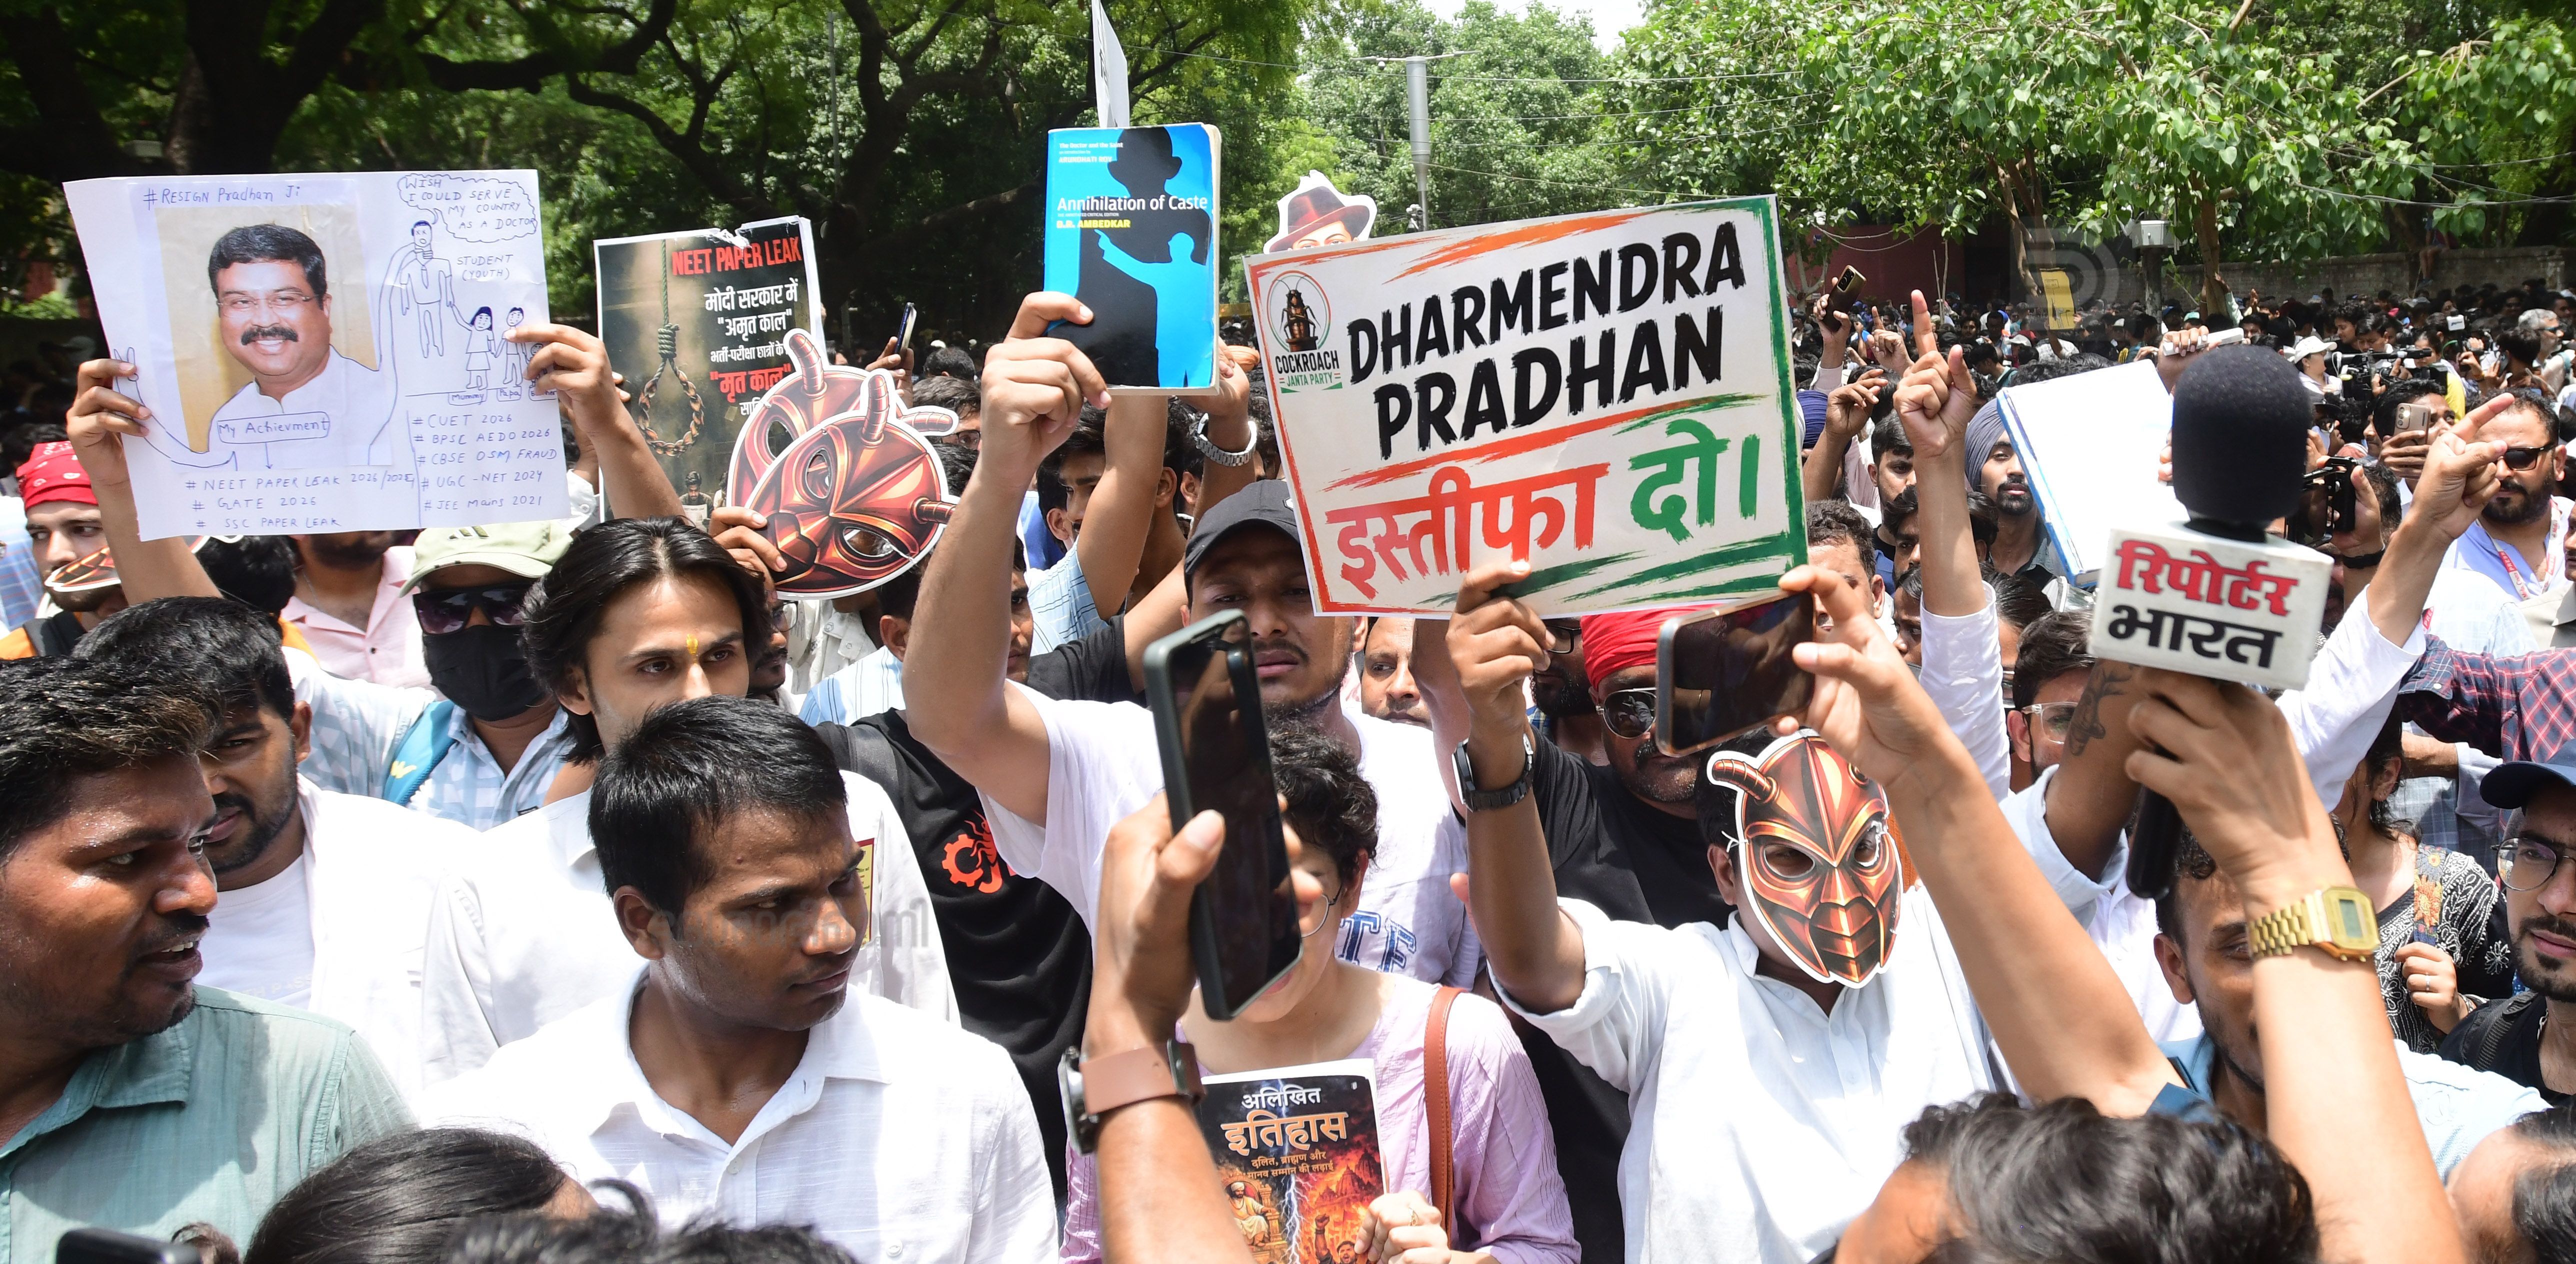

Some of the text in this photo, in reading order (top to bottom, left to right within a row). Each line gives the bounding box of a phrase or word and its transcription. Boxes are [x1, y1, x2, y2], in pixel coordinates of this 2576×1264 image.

[406, 178, 442, 189] WISH
[218, 187, 274, 202] Pradhan
[286, 185, 300, 198] Ji
[410, 188, 512, 202] I COULD SERVE
[448, 202, 520, 218] MY COUNTRY
[1057, 194, 1208, 212] Annihilation of Caste
[459, 221, 472, 229] AS
[494, 218, 536, 230] DOCTOR
[1078, 220, 1130, 228] AMBEDKAR
[456, 254, 514, 265] STUDENT
[672, 236, 802, 276] NEET PAPER LEAK
[462, 268, 510, 282] (YOUTH)
[704, 278, 799, 312] मोदी सरकार में
[1346, 220, 1747, 386] DHARMENDRA
[756, 341, 774, 358] छात्रों
[1275, 350, 1340, 374] COCKROACH
[1287, 372, 1332, 387] JANTA PARTY
[1374, 304, 1725, 461] PRADHAN
[452, 392, 484, 405] Mummy
[500, 390, 521, 400] Papa
[218, 419, 330, 438] My Achievment
[428, 414, 472, 428] CUET
[482, 414, 512, 424] 2026
[432, 434, 467, 445] BPSC
[476, 432, 516, 442] AEDO
[522, 428, 550, 440] 2026
[432, 452, 466, 465] CBSE
[476, 450, 511, 463] OSM
[516, 449, 557, 460] FRAUD
[204, 479, 246, 490] NEET
[256, 478, 298, 489] PAPER
[304, 476, 340, 486] LEAK
[436, 475, 466, 488] UGC
[514, 470, 542, 482] 2024
[217, 498, 264, 510] GATE
[280, 496, 316, 506] 2026
[436, 500, 459, 510] JEE
[468, 500, 504, 508] Mains
[512, 496, 542, 506] 2021
[224, 518, 250, 529] SSC
[261, 518, 298, 528] PAPER
[306, 518, 342, 528] LEAK
[1326, 461, 1610, 600] इस्तीफा
[2114, 539, 2300, 616] रिपोर्टर
[2108, 604, 2283, 670] भारत
[1241, 1083, 1322, 1109] अलिखित
[1220, 1109, 1348, 1156] इतिहास
[1309, 1148, 1326, 1160] और
[1270, 1166, 1296, 1177] सम्मान
[1298, 1163, 1310, 1174] की
[1311, 1160, 1334, 1172] लड़ाई
